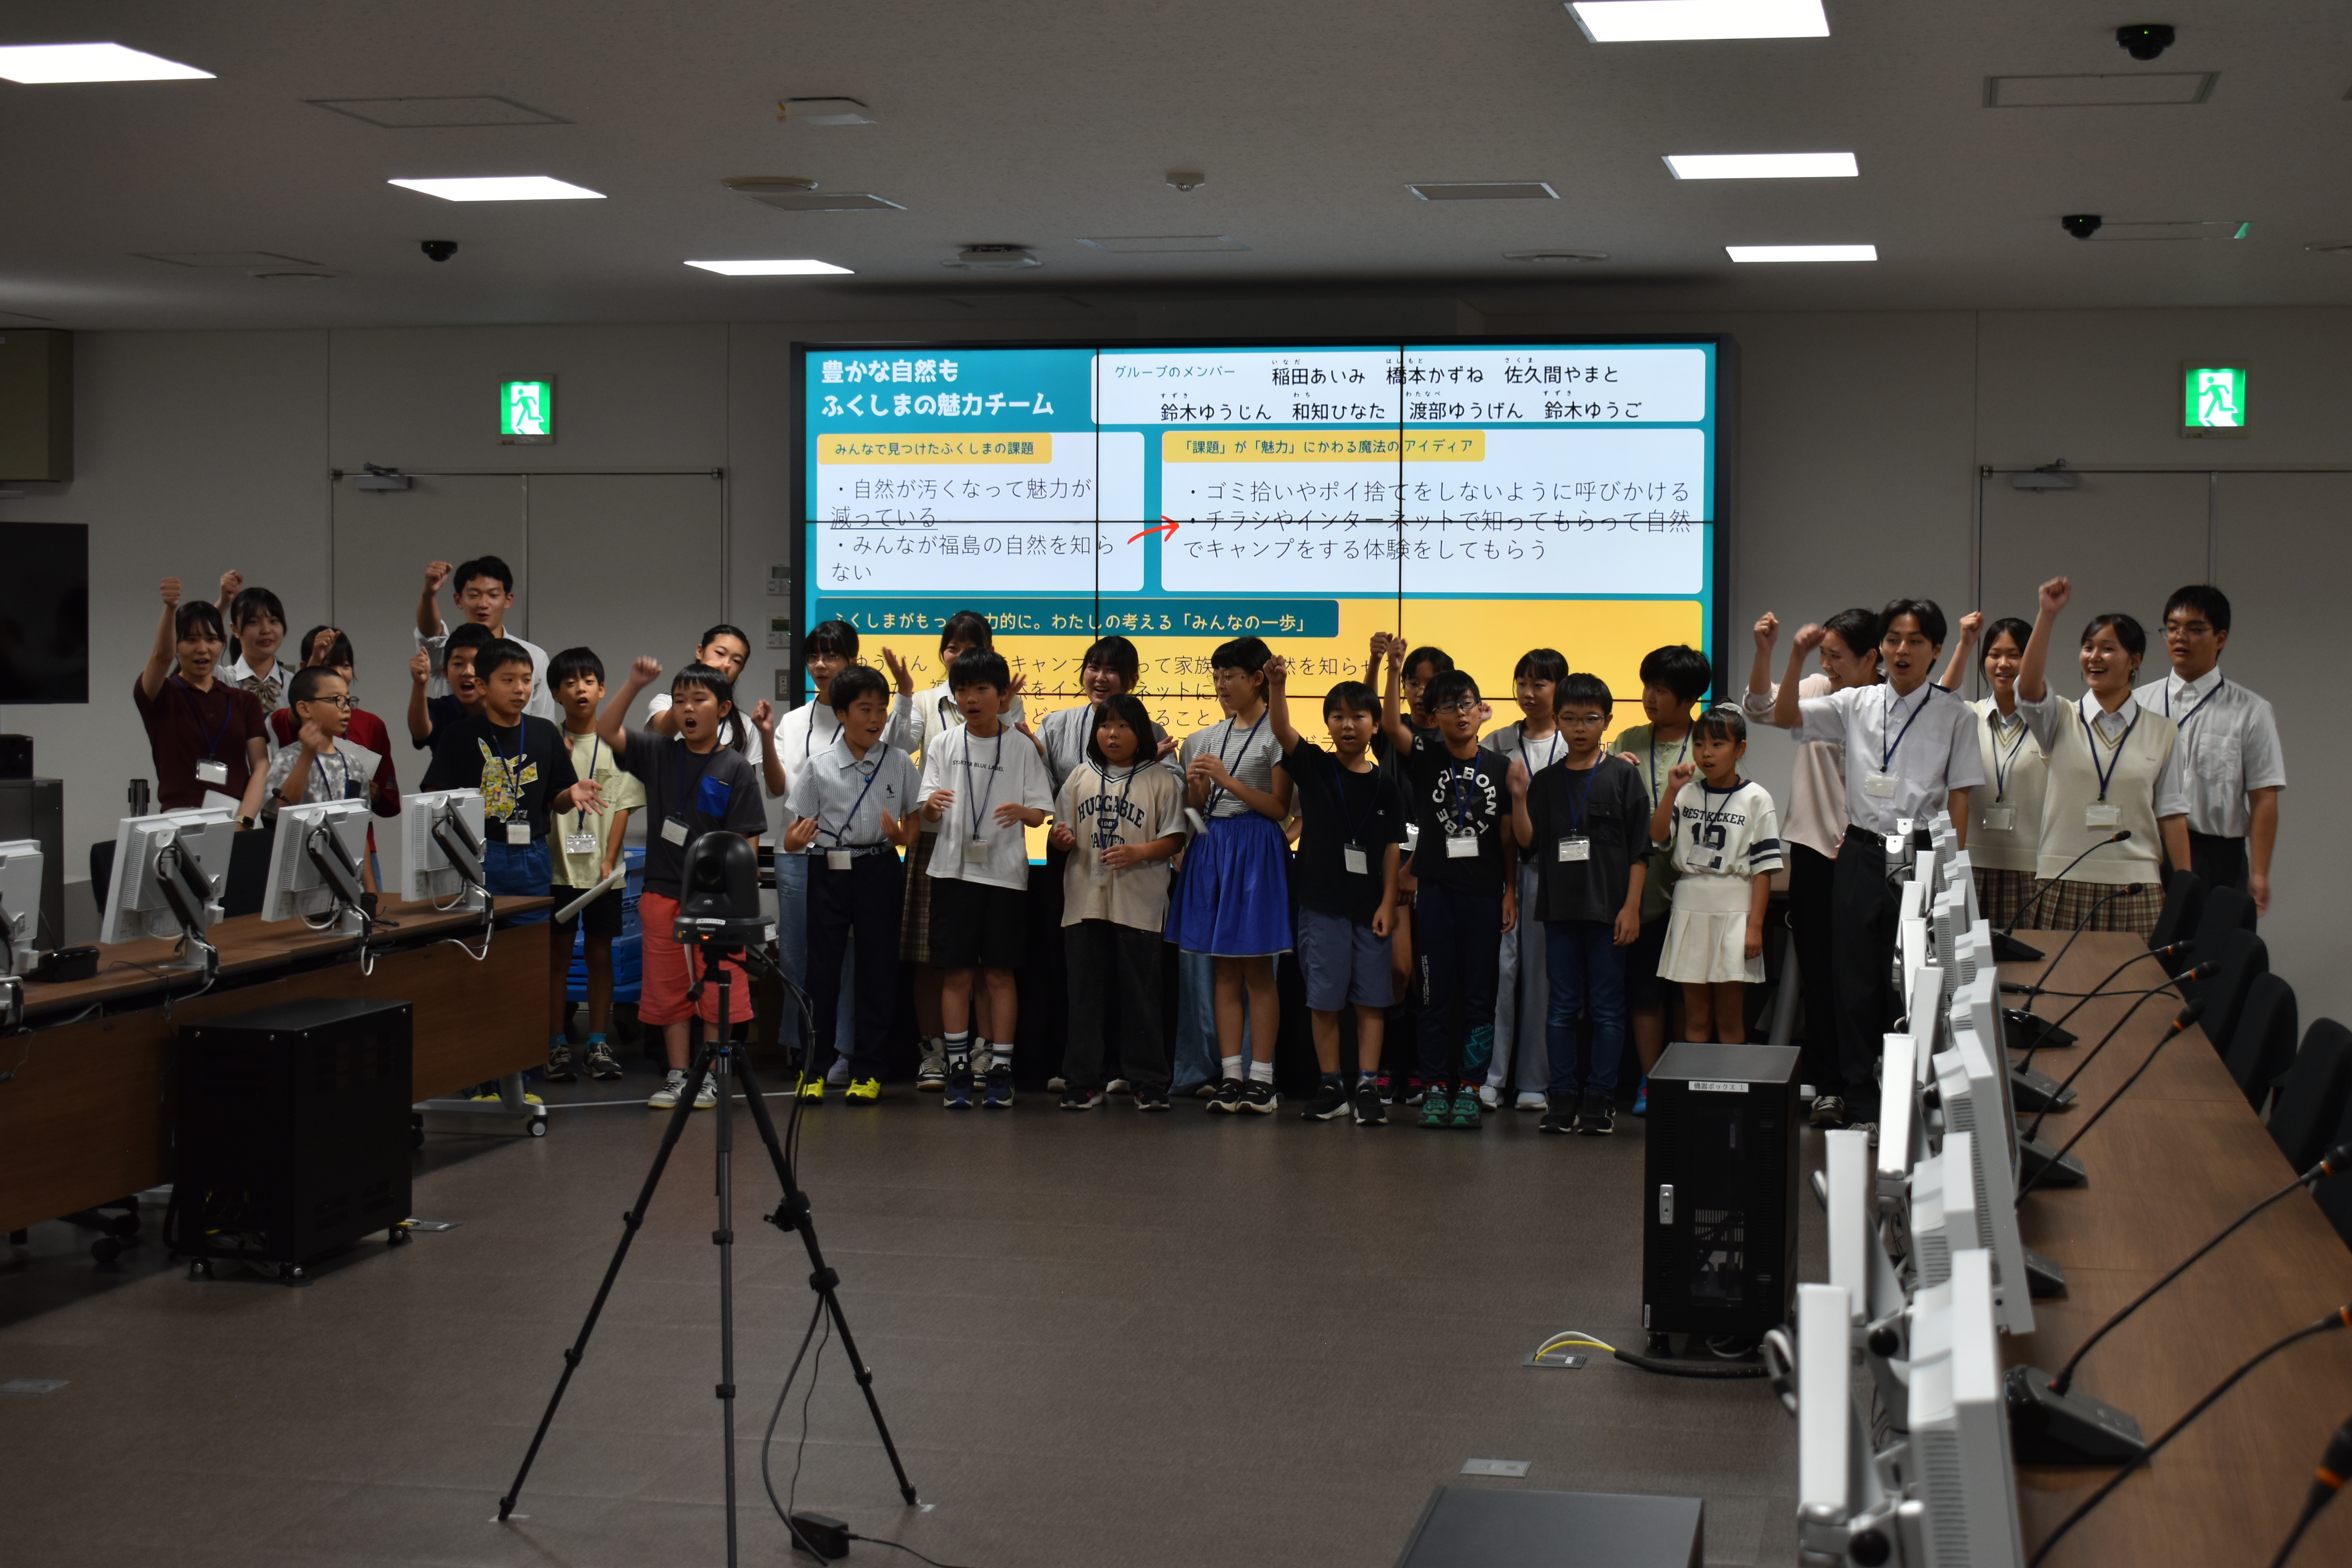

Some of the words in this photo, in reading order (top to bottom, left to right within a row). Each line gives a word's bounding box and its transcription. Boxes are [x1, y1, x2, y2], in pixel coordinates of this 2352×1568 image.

[822, 359, 958, 383] 豊かな自然も
[1115, 365, 1235, 378] グループのメンバー
[1272, 368, 1365, 386] 稲田あいみ
[1387, 367, 1483, 385] 橋本かずね
[1504, 366, 1618, 384] 佐久間やまと
[822, 393, 1054, 417] ふくしまの魅力チーム
[1161, 403, 1271, 421] 鈴木ゆうじん
[1292, 403, 1385, 421] 和知ひなた
[1410, 402, 1523, 420] 渡部ゆうげん
[1544, 401, 1642, 419] 鈴木ゆうご
[835, 442, 1034, 456] みんなで見つけたふくしまの課題
[831, 506, 936, 528] 減っている
[1184, 538, 1546, 560] でキャンプをする体験をしてもらう
[832, 563, 871, 581] ない
[1078, 794, 1145, 829] HUGGABLE
[1682, 806, 1705, 820] BEST
[1706, 811, 1746, 826] KICKER
[1694, 1082, 1735, 1091] 機器ボックス
